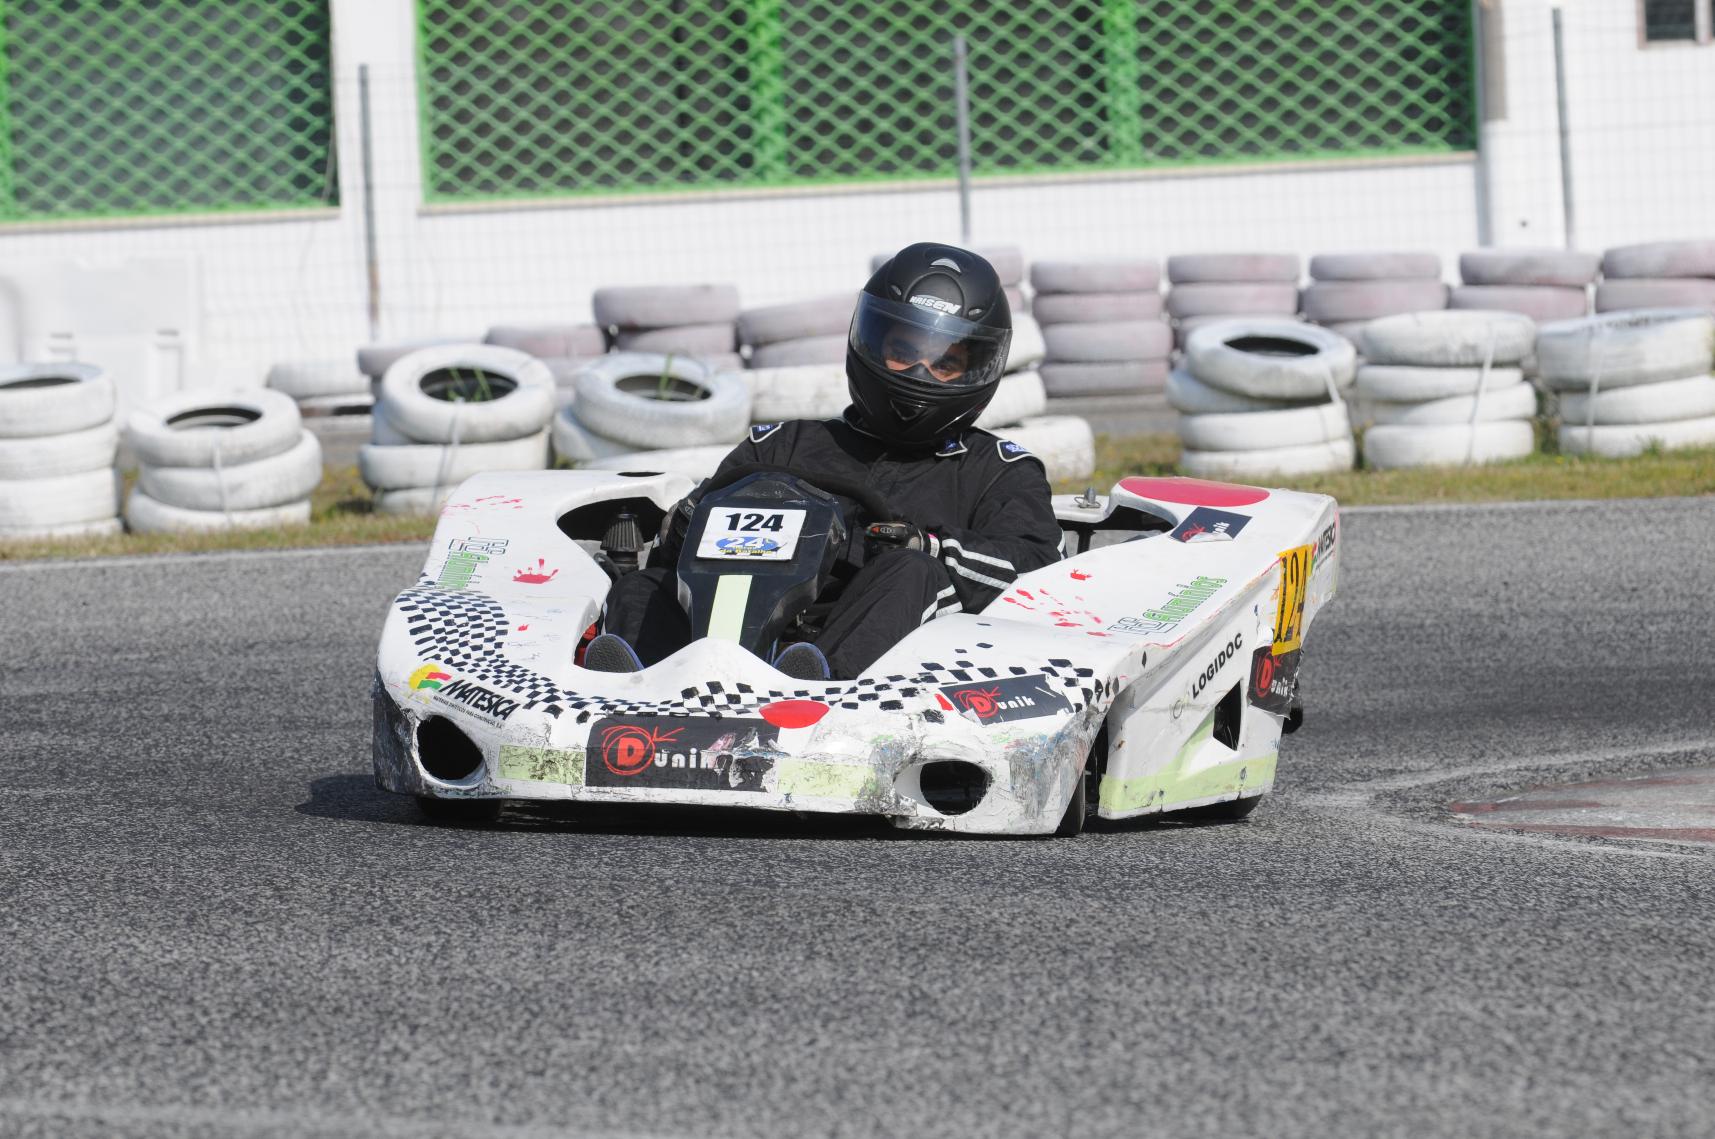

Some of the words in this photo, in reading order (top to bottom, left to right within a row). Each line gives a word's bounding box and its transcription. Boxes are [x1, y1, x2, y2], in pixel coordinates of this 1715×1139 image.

[725, 512, 784, 532] 124
[724, 536, 766, 549] 24
[1192, 632, 1243, 700] LOGIDOC
[439, 679, 521, 721] MATESICA
